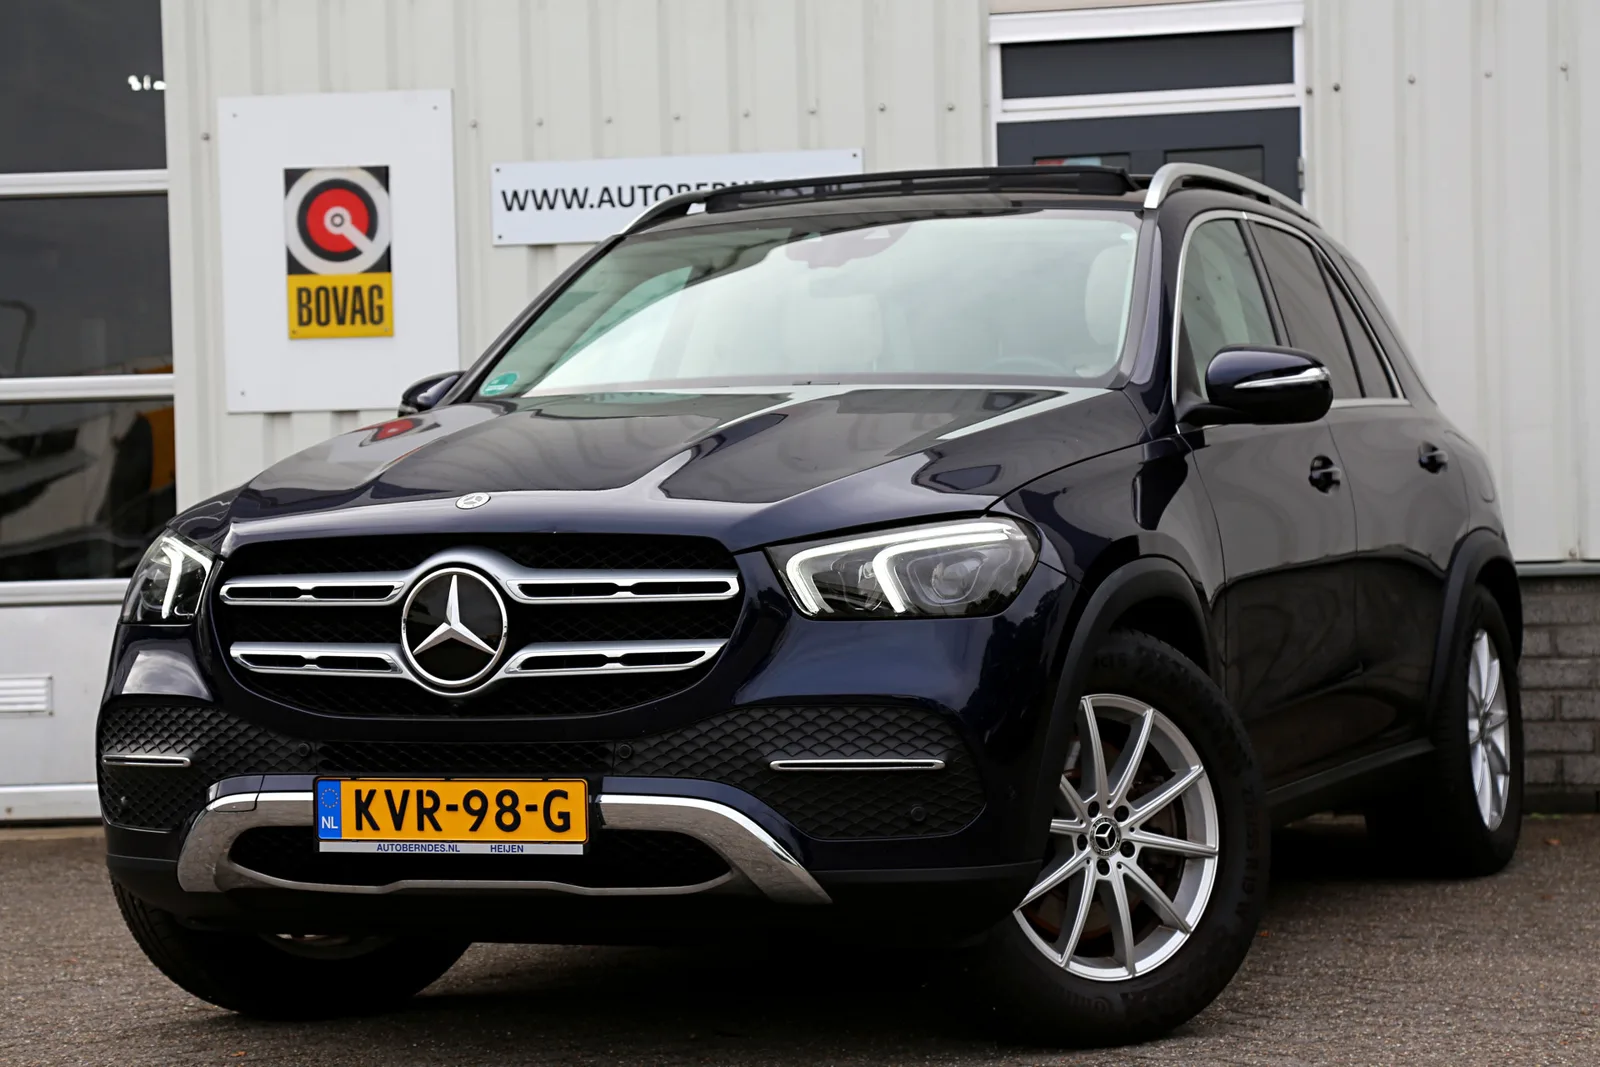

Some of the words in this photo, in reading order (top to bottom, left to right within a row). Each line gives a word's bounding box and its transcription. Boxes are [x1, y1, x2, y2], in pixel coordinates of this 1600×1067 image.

[297, 284, 384, 327] BOVAG
[321, 815, 339, 829] NL
[354, 789, 571, 833] KVR-98-G
[376, 843, 461, 853] AUTOBERNDES.NL
[490, 844, 524, 853] HEIJEN
